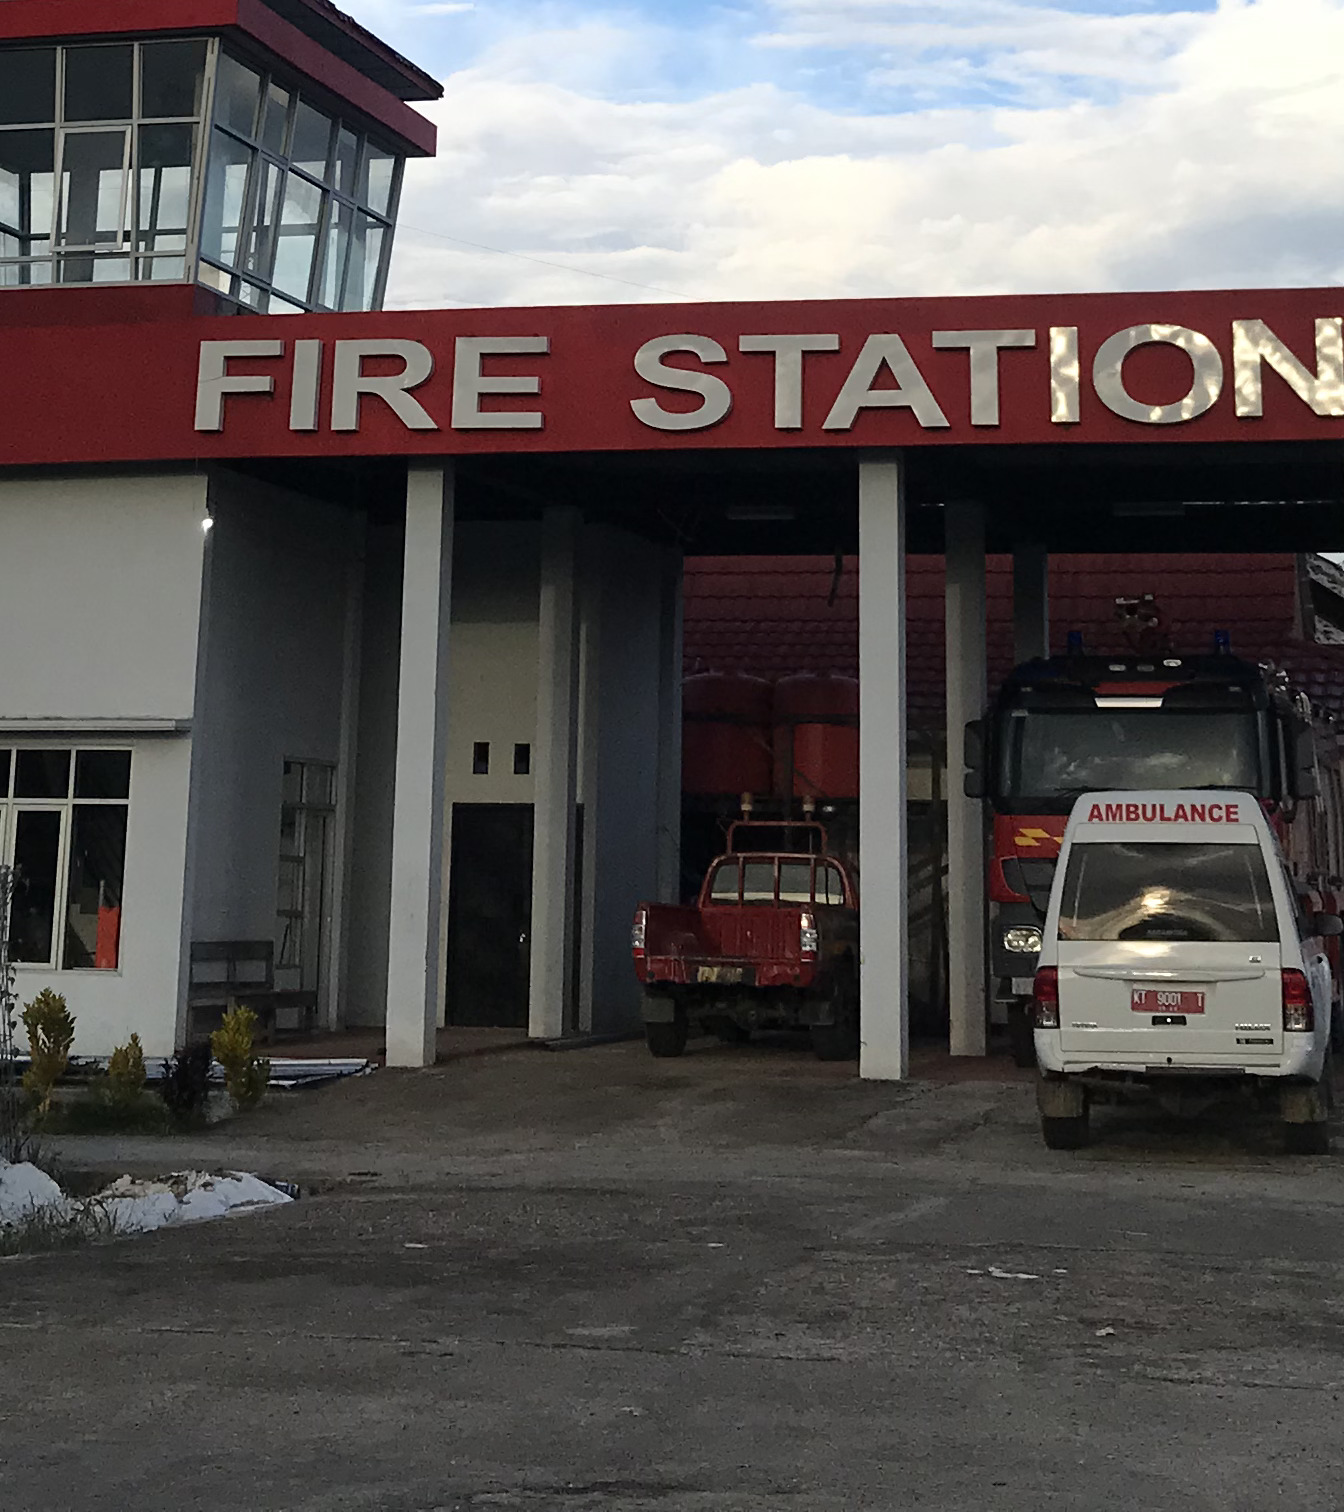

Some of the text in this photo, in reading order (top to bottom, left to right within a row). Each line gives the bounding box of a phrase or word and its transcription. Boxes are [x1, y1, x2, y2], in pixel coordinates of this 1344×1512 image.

[193, 336, 550, 433] FIRE
[1087, 803, 1240, 823] AMBULANCE
[1157, 992, 1182, 1006] 9001
[1196, 993, 1203, 1007] T
